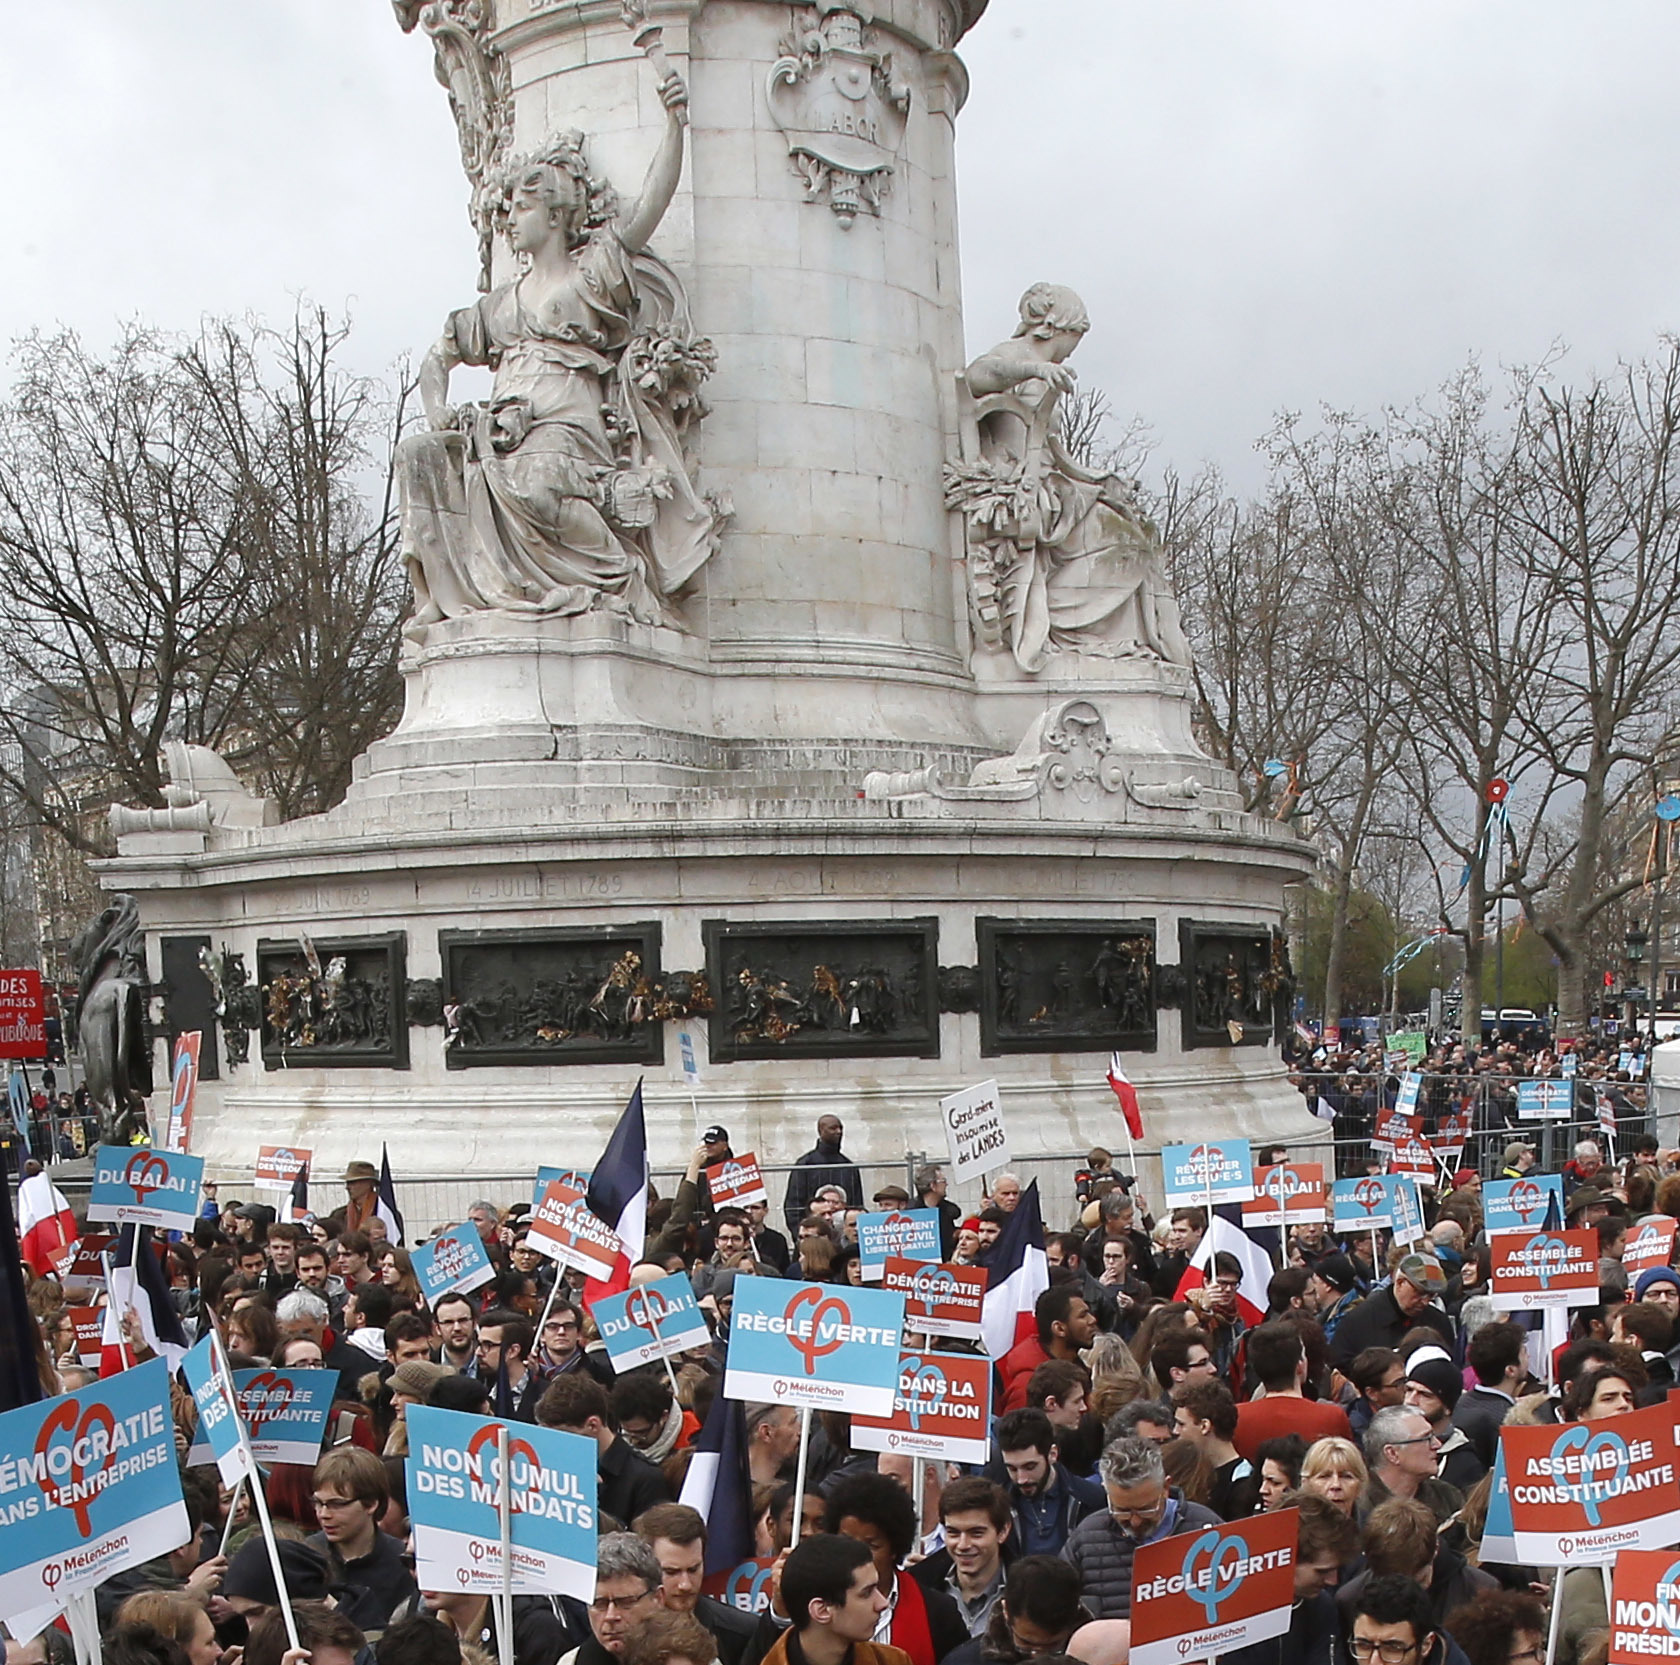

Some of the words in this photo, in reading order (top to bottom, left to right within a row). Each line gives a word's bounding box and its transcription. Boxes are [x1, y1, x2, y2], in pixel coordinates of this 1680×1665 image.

[1521, 1088, 1569, 1097] DÉMOCRATIE
[971, 1129, 1005, 1159] LANDES
[1175, 1159, 1240, 1175] RÉVOQUER
[98, 1169, 127, 1185] DU
[129, 1170, 185, 1193] BALAI
[710, 1183, 730, 1196] DES
[727, 1173, 759, 1193] MÉDIAS
[1174, 1174, 1196, 1187] LES
[1269, 1180, 1313, 1197] BALAI
[545, 1197, 575, 1219] NON
[1335, 1191, 1370, 1204] RÈGLE
[1488, 1197, 1514, 1206] DROIT
[1488, 1204, 1512, 1214] DANS
[538, 1207, 563, 1227] DES
[562, 1218, 620, 1252] MANDATS
[862, 1220, 936, 1236] CHANGEMENT
[864, 1234, 904, 1246] D'ÉTAT
[906, 1232, 936, 1242] CIVIL
[865, 1244, 890, 1254] LIBRE
[79, 1250, 100, 1262] DU
[425, 1243, 474, 1276] RÉVOQUER
[1507, 1245, 1582, 1262] ASSEMBLÉE
[429, 1272, 447, 1288] LES
[1495, 1262, 1595, 1279] CONSTITUANTE
[886, 1272, 981, 1296] DÉMOCRATIE
[914, 1292, 980, 1308] L'ENTREPRISE
[602, 1318, 631, 1337] DU
[633, 1299, 685, 1325] BALAI
[736, 1310, 812, 1338] RÈGLE
[819, 1321, 897, 1347] VERTE
[789, 1381, 845, 1398] Mélenchon
[899, 1375, 948, 1394] DANS
[951, 1382, 975, 1398] LA
[900, 1434, 944, 1448] Mélenchon
[1526, 1439, 1654, 1476] ASSEMBLÉE
[44, 1442, 169, 1513] L'ENTREPRISE
[422, 1444, 482, 1477] NON
[489, 1458, 585, 1500] CUMUL
[1513, 1463, 1675, 1504] CONSTITUANTE
[415, 1470, 465, 1499] DES
[470, 1481, 593, 1529] MANDATS
[1575, 1528, 1640, 1548] Mélenchon
[63, 1534, 129, 1570] Mélenchon
[1135, 1575, 1213, 1603] RÈGLE
[1218, 1547, 1292, 1582] VERTE
[1193, 1625, 1247, 1647] Mélenchon
